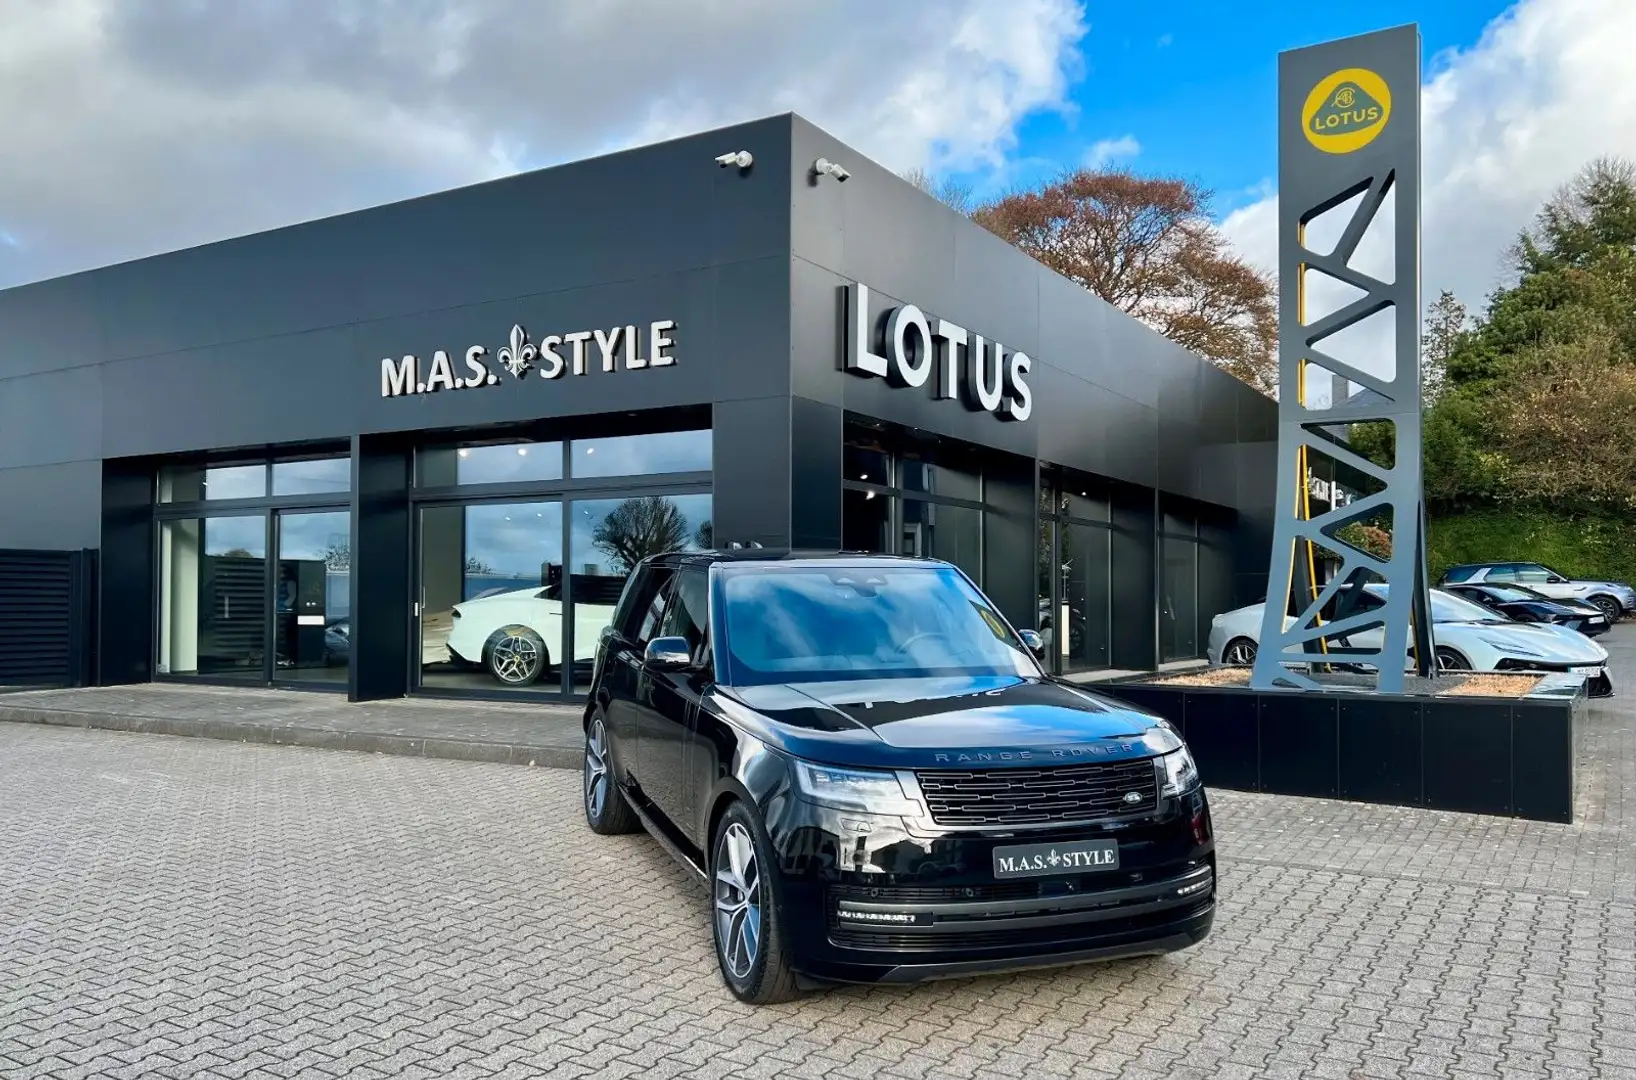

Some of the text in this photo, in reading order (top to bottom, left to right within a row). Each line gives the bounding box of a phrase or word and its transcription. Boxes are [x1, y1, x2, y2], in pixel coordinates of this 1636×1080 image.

[1315, 107, 1379, 130] LOTUS
[381, 320, 677, 398] M.A.S. STYLE
[848, 282, 1032, 422] LOTUS
[935, 744, 1134, 762] RANGE ROVER
[998, 849, 1115, 873] M.A.S. STYLE
